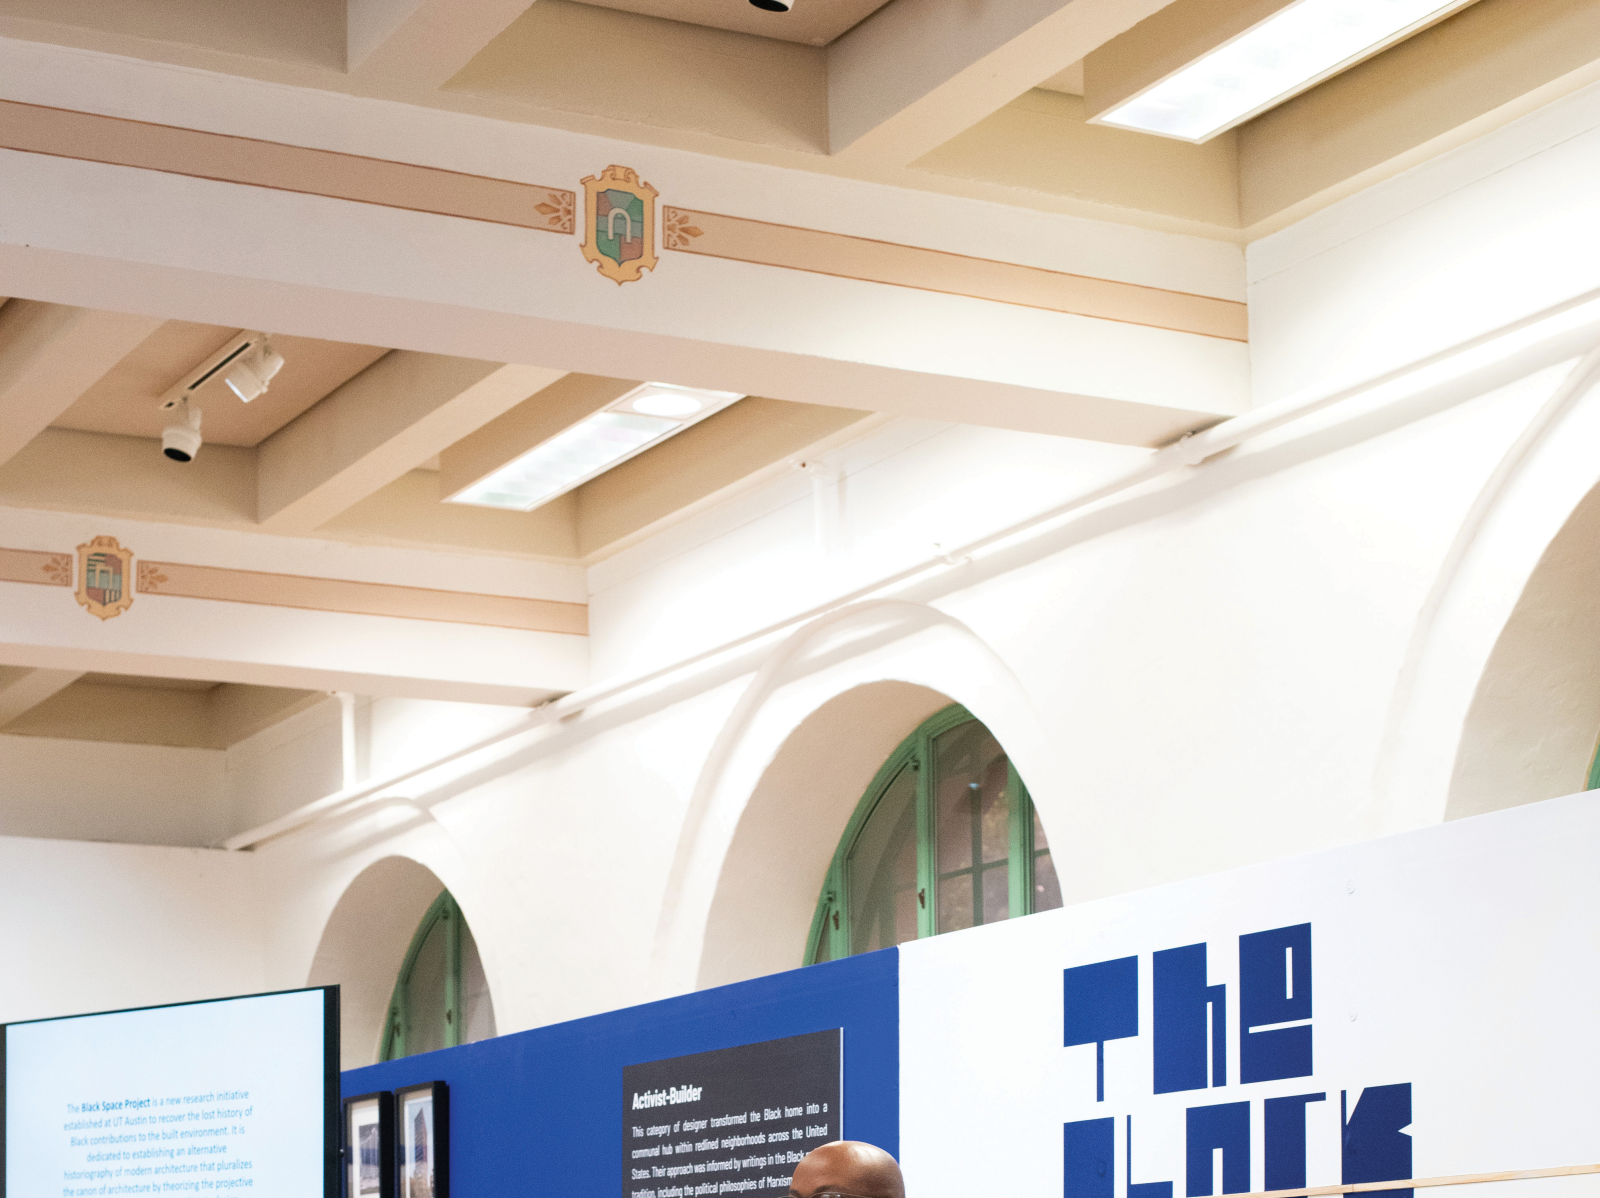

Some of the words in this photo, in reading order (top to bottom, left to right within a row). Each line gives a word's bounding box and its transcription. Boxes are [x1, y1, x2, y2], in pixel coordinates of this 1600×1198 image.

[1064, 922, 1312, 1101] The
[67, 1104, 79, 1113] The
[82, 1102, 100, 1112] Black
[102, 1101, 122, 1112] Space
[125, 1099, 150, 1110] Project
[152, 1097, 157, 1107] is
[184, 1092, 214, 1104] research
[217, 1090, 249, 1101] initiative
[632, 1084, 702, 1110] Activist-Builder
[64, 1118, 102, 1131] established
[104, 1119, 111, 1127] at
[114, 1116, 122, 1127] UT
[125, 1117, 147, 1125] Austin
[149, 1116, 156, 1124] to
[159, 1114, 185, 1123] recover
[188, 1111, 199, 1121] the
[202, 1110, 215, 1120] lost
[217, 1108, 242, 1119] history
[245, 1105, 253, 1116] of
[632, 1126, 644, 1137] This
[647, 1125, 671, 1137] category
[673, 1121, 680, 1132] of
[683, 1119, 707, 1132] designer
[711, 1112, 747, 1127] transformed
[750, 1111, 760, 1122] the
[764, 1107, 781, 1120] Black
[785, 1106, 802, 1117] home
[806, 1103, 819, 1114] into
[823, 1103, 827, 1112] a
[71, 1136, 88, 1147] Black
[90, 1134, 136, 1145] contributions
[139, 1133, 146, 1141] to
[148, 1131, 159, 1141] the
[162, 1129, 178, 1140] built
[180, 1127, 229, 1139] environment.
[231, 1125, 237, 1135] It
[240, 1126, 245, 1134] is
[632, 1145, 660, 1159] communal
[662, 1144, 673, 1155] hub
[675, 1141, 693, 1153] within
[695, 1138, 718, 1151] redlined
[721, 1132, 765, 1150] neighborhoods
[768, 1132, 789, 1142] across
[792, 1128, 803, 1139] the
[806, 1124, 827, 1138] United
[87, 1150, 120, 1162] dedicated
[123, 1151, 130, 1160] to
[132, 1148, 174, 1159] establishing
[176, 1148, 185, 1156] an
[188, 1145, 226, 1155] alternative
[632, 1169, 651, 1180] States.
[652, 1166, 666, 1177] Their
[667, 1163, 693, 1178] approach
[694, 1164, 705, 1173] was
[707, 1158, 732, 1171] informed
[734, 1158, 741, 1171] by
[742, 1155, 766, 1169] writings
[768, 1154, 774, 1165] in
[775, 1153, 785, 1164] the
[787, 1150, 804, 1163] Black
[64, 1168, 112, 1181] historiography
[115, 1166, 122, 1177] of
[124, 1166, 152, 1176] modern
[154, 1164, 197, 1174] architecture
[200, 1162, 214, 1171] that
[217, 1159, 252, 1172] pluralizes
[63, 1187, 74, 1197] the
[76, 1188, 97, 1196] canon
[99, 1184, 106, 1195] of
[108, 1184, 150, 1194] architecture
[153, 1182, 161, 1193] by
[163, 1181, 199, 1192] theorizing
[202, 1179, 213, 1189] the
[216, 1178, 253, 1190] projective
[658, 1186, 682, 1198] including
[684, 1185, 693, 1196] the
[695, 1182, 718, 1197] political
[720, 1178, 757, 1195] philosophies
[758, 1177, 765, 1189] of
